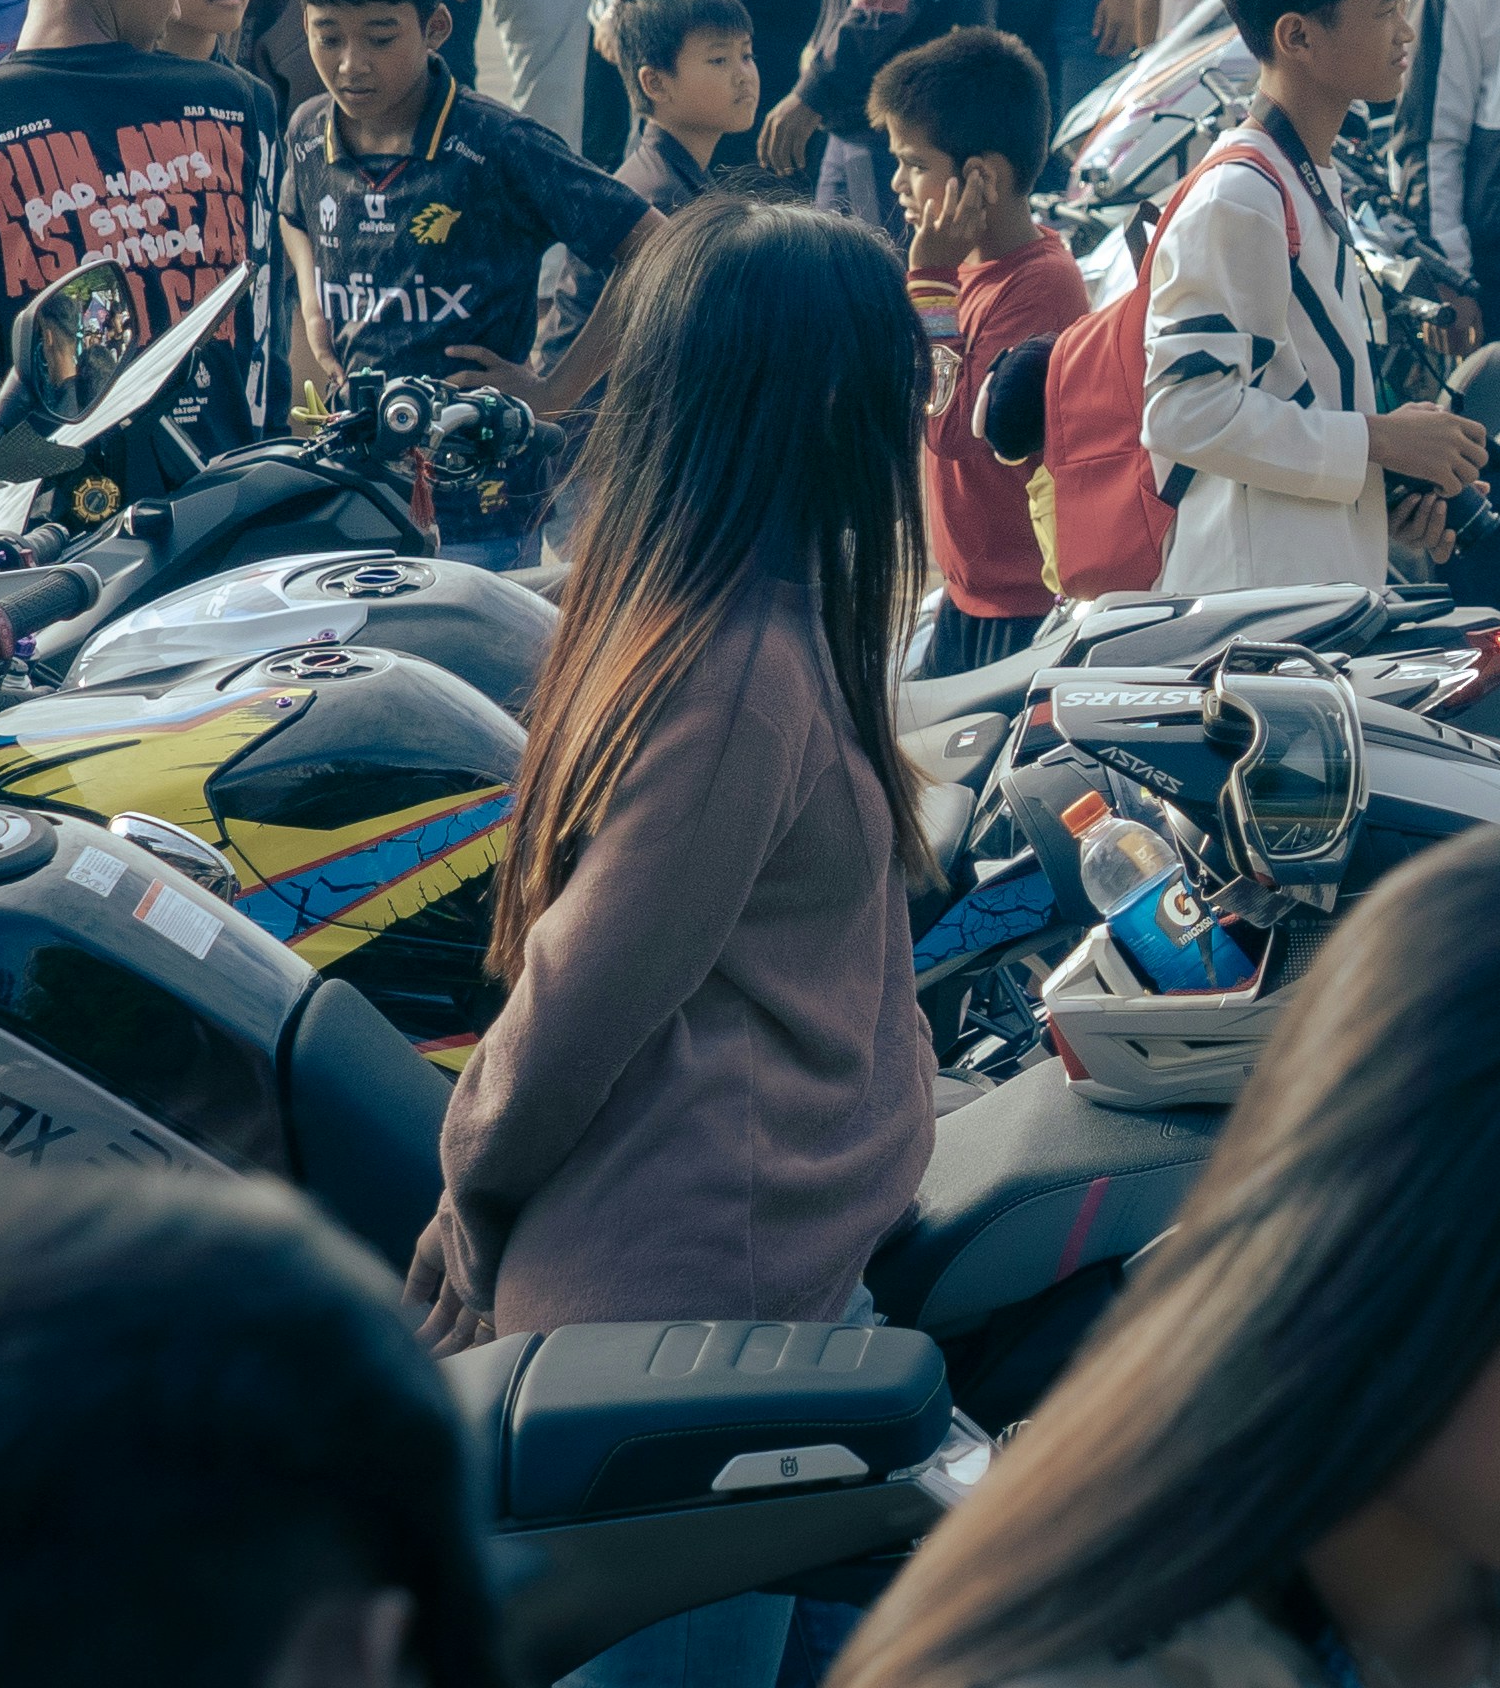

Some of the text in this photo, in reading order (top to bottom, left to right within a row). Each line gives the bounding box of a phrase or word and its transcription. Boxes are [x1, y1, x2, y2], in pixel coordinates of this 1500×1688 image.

[183, 105, 205, 117] BAD
[25, 151, 212, 241] BAD HABITS
[89, 196, 167, 236] STEP
[80, 224, 207, 268] OUTSIDE
[358, 221, 396, 235] dailybox
[314, 265, 473, 323] Infinix
[1096, 746, 1185, 795] ASTARS
